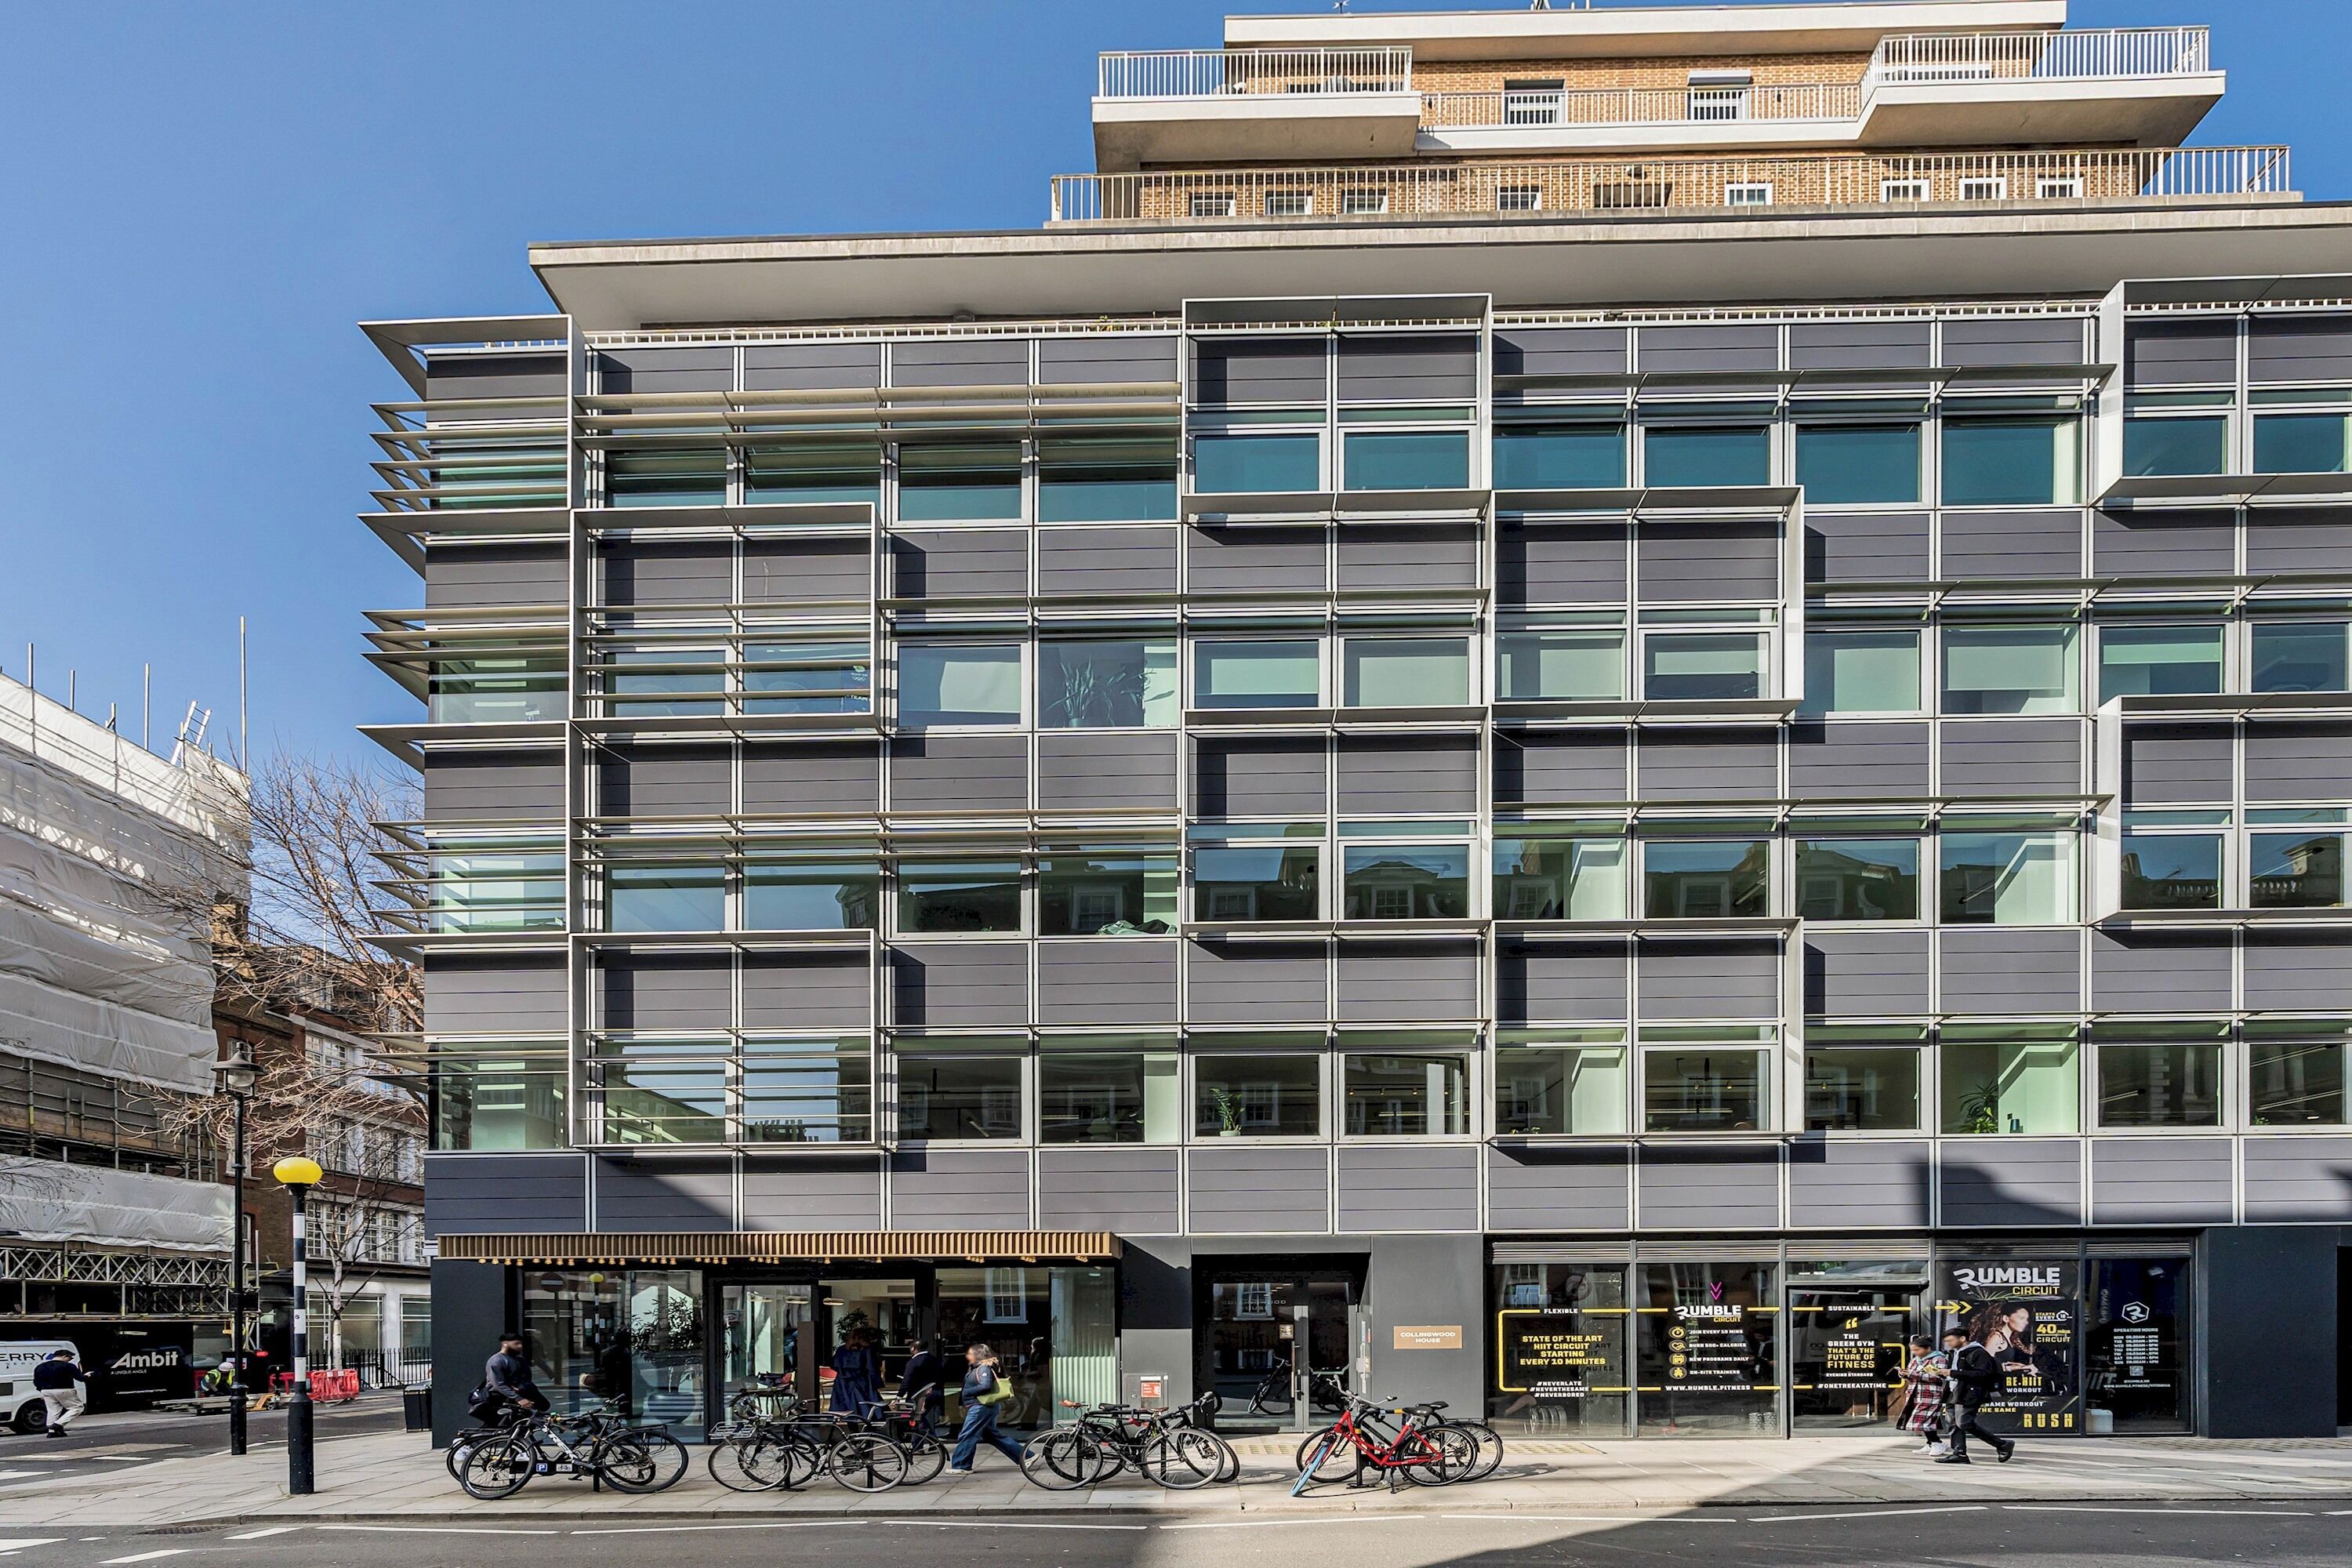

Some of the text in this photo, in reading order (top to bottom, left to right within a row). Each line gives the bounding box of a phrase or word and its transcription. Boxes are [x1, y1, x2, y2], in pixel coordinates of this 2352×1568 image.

[1953, 1267, 2060, 1290] RUMBLE
[2013, 1287, 2060, 1295] CIRCUIT
[1674, 1305, 1742, 1320] RUMBLE
[2036, 1323, 2057, 1334] 40
[111, 1351, 178, 1369] Ambit
[1827, 1360, 1875, 1369] FITNESS
[2024, 1414, 2073, 1428] RUSH
[542, 1425, 579, 1459] TREK
